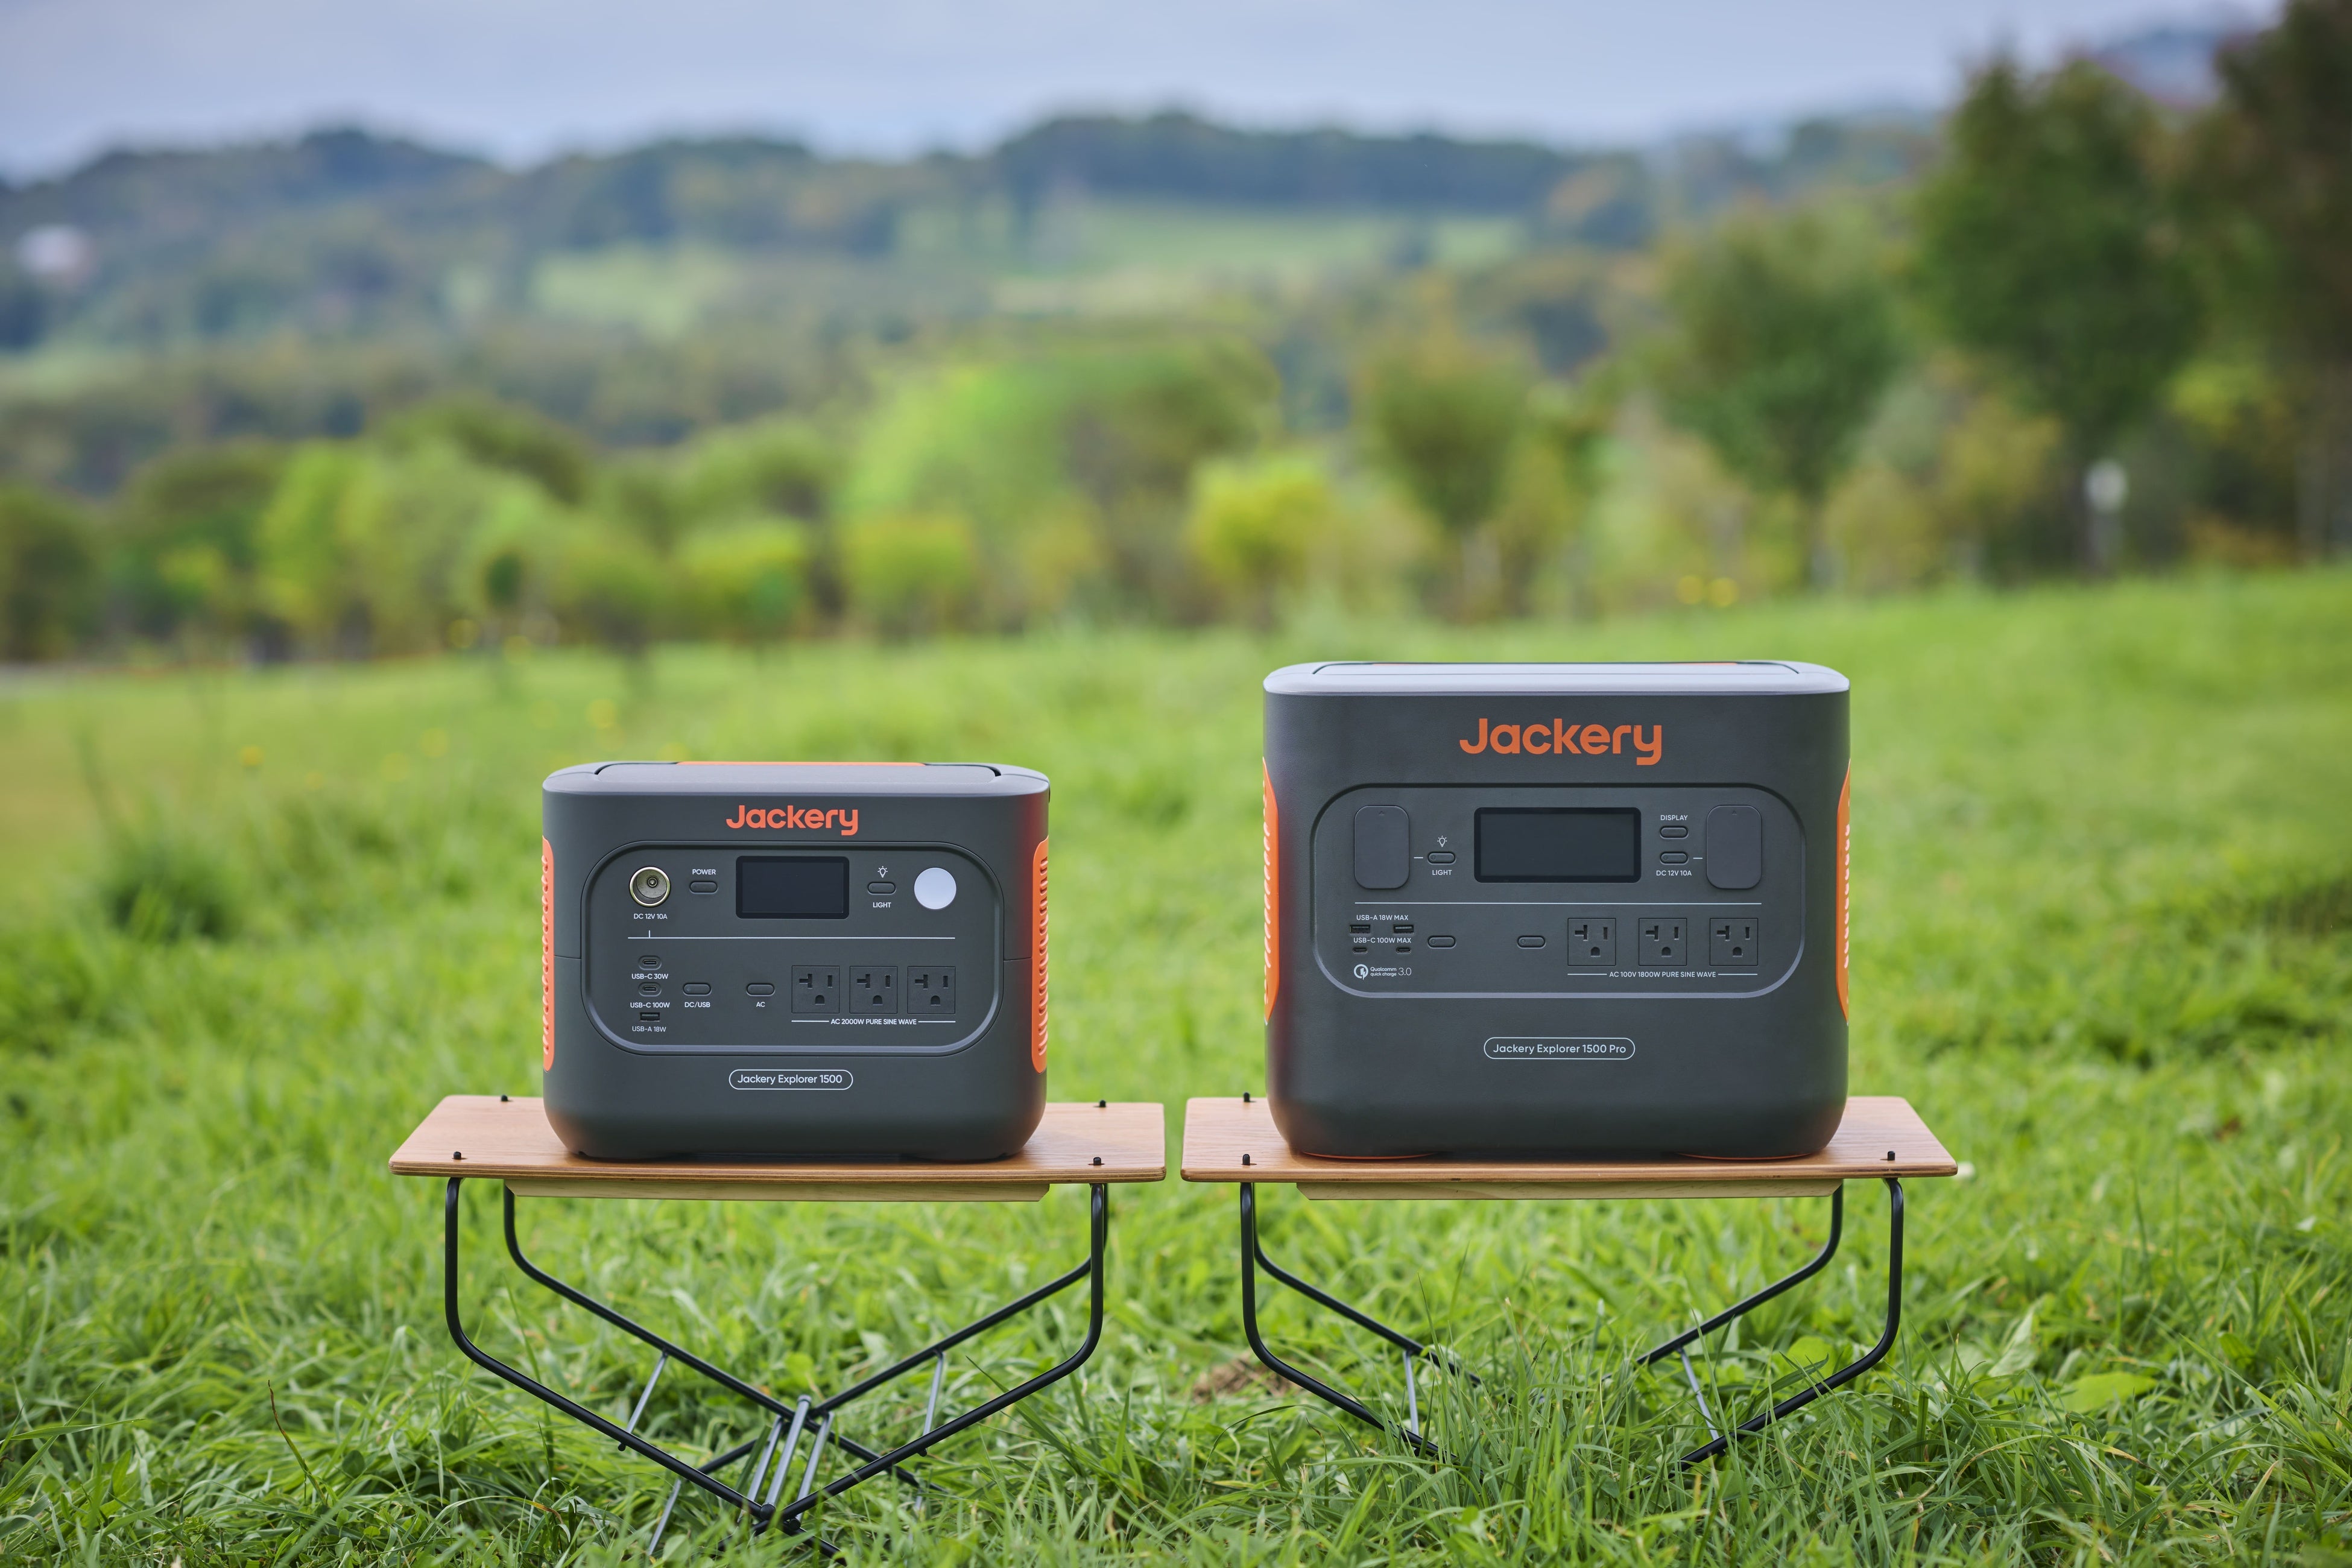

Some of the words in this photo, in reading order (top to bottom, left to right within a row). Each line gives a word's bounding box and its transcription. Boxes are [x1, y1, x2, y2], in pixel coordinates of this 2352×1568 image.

[1459, 718, 1662, 766] Jackery
[726, 805, 858, 836] Jackery
[1398, 967, 1412, 976] 3.0
[1493, 1044, 1535, 1055] Jackery
[1537, 1043, 1581, 1055] Explorer
[1582, 1044, 1607, 1054] 1500
[1609, 1044, 1626, 1054] Pro
[737, 1074, 776, 1086] Jackery
[778, 1074, 818, 1086] Explorer
[819, 1074, 842, 1084] 1500
